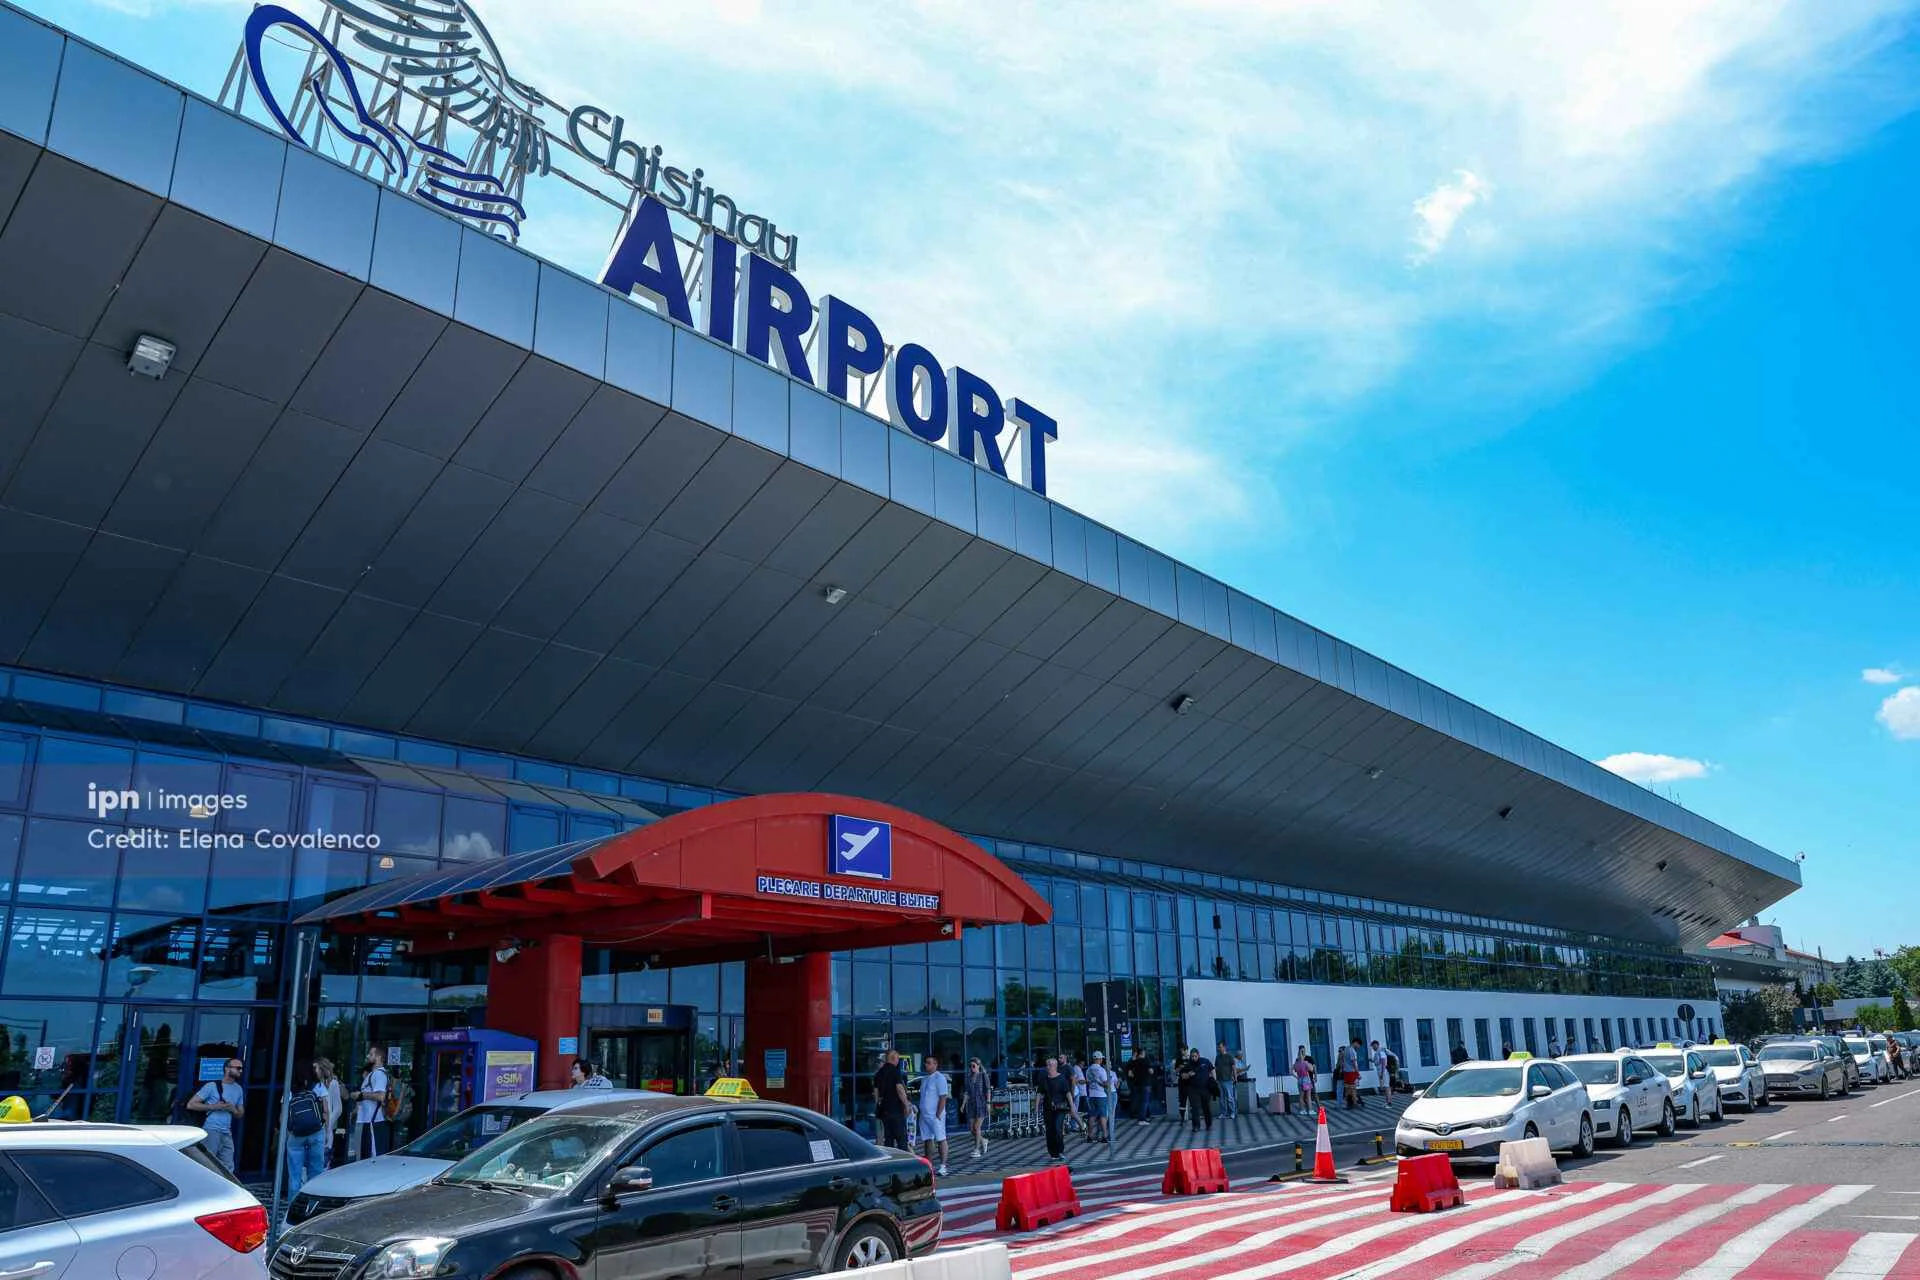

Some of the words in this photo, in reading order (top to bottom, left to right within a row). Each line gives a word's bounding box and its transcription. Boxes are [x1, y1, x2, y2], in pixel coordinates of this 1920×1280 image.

[567, 105, 798, 272] Chisinau
[598, 195, 1058, 497] AIRPORT
[758, 876, 820, 898] PLECARE
[823, 883, 897, 905] DEPARTURE
[899, 892, 939, 910] ВЫЛЕТ
